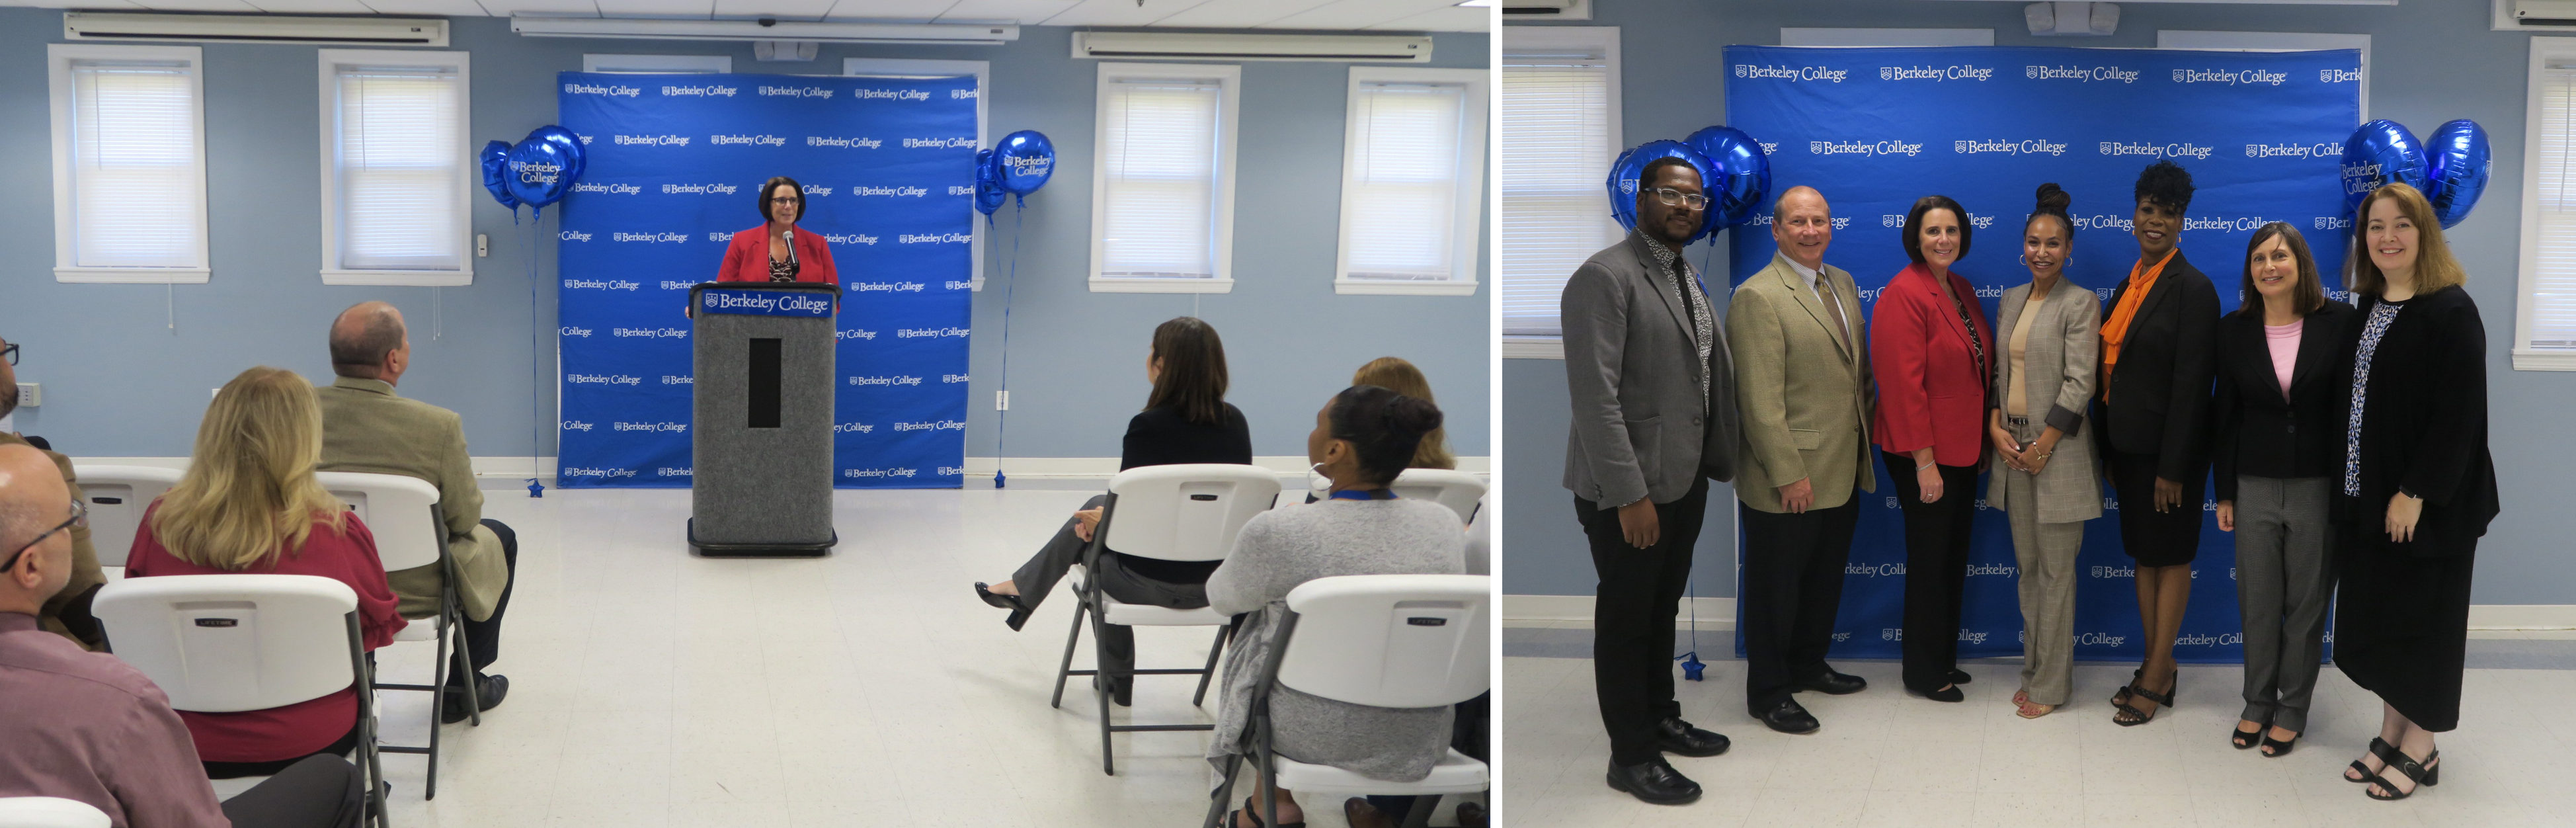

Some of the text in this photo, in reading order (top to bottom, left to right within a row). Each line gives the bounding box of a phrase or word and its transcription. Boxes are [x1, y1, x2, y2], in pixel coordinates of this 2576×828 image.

[1749, 65, 1847, 83] Berkeley College
[1894, 65, 1992, 82] Berkeley College
[2039, 65, 2138, 83] Berkeley College
[2186, 69, 2286, 86] Berkeley College
[574, 84, 639, 97] Berkeley College
[671, 85, 737, 97] Berkeley College
[768, 87, 833, 99] Berkeley College
[864, 89, 930, 101] Berkeley College
[624, 136, 689, 146] Berkeley College
[721, 134, 785, 146] Berkeley College
[816, 137, 881, 149] Berkeley College
[912, 137, 977, 149] Berkeley College
[1824, 140, 1921, 157] Berkeley College
[1968, 139, 2066, 156] Berkeley College
[2113, 142, 2212, 160] Berkeley College
[2259, 143, 2311, 160] Berkeley
[1014, 155, 1051, 167] Berkeley
[520, 161, 560, 175] Berkeley
[1016, 165, 1048, 177] College
[2341, 161, 2382, 180] Berkeley
[521, 172, 557, 185] College
[575, 183, 640, 194] Berkeley College
[672, 184, 736, 195] Berkeley College
[803, 185, 832, 196] College
[862, 186, 926, 197] Berkeley College
[2183, 217, 2234, 233] Berkeley
[561, 231, 591, 241] College
[622, 232, 687, 243] Berkeley College
[848, 235, 877, 245] College
[908, 233, 971, 244] Berkeley College
[574, 280, 639, 291] Berkeley College
[860, 282, 924, 293] Berkeley College
[720, 294, 828, 314] Berkeley College
[562, 327, 592, 337] College
[623, 328, 687, 339] Berkeley College
[847, 329, 876, 339] College
[906, 327, 969, 339] Berkeley College
[577, 374, 641, 386] Berkeley College
[859, 376, 922, 386] Berkeley College
[564, 421, 592, 431] College
[623, 423, 686, 433] Berkeley College
[844, 423, 873, 433] College
[903, 420, 965, 431] Berkeley College
[573, 468, 637, 478] Berkeley College
[854, 468, 916, 478] Berkeley College
[1966, 563, 2015, 578] Berkeley
[2081, 633, 2124, 647] College
